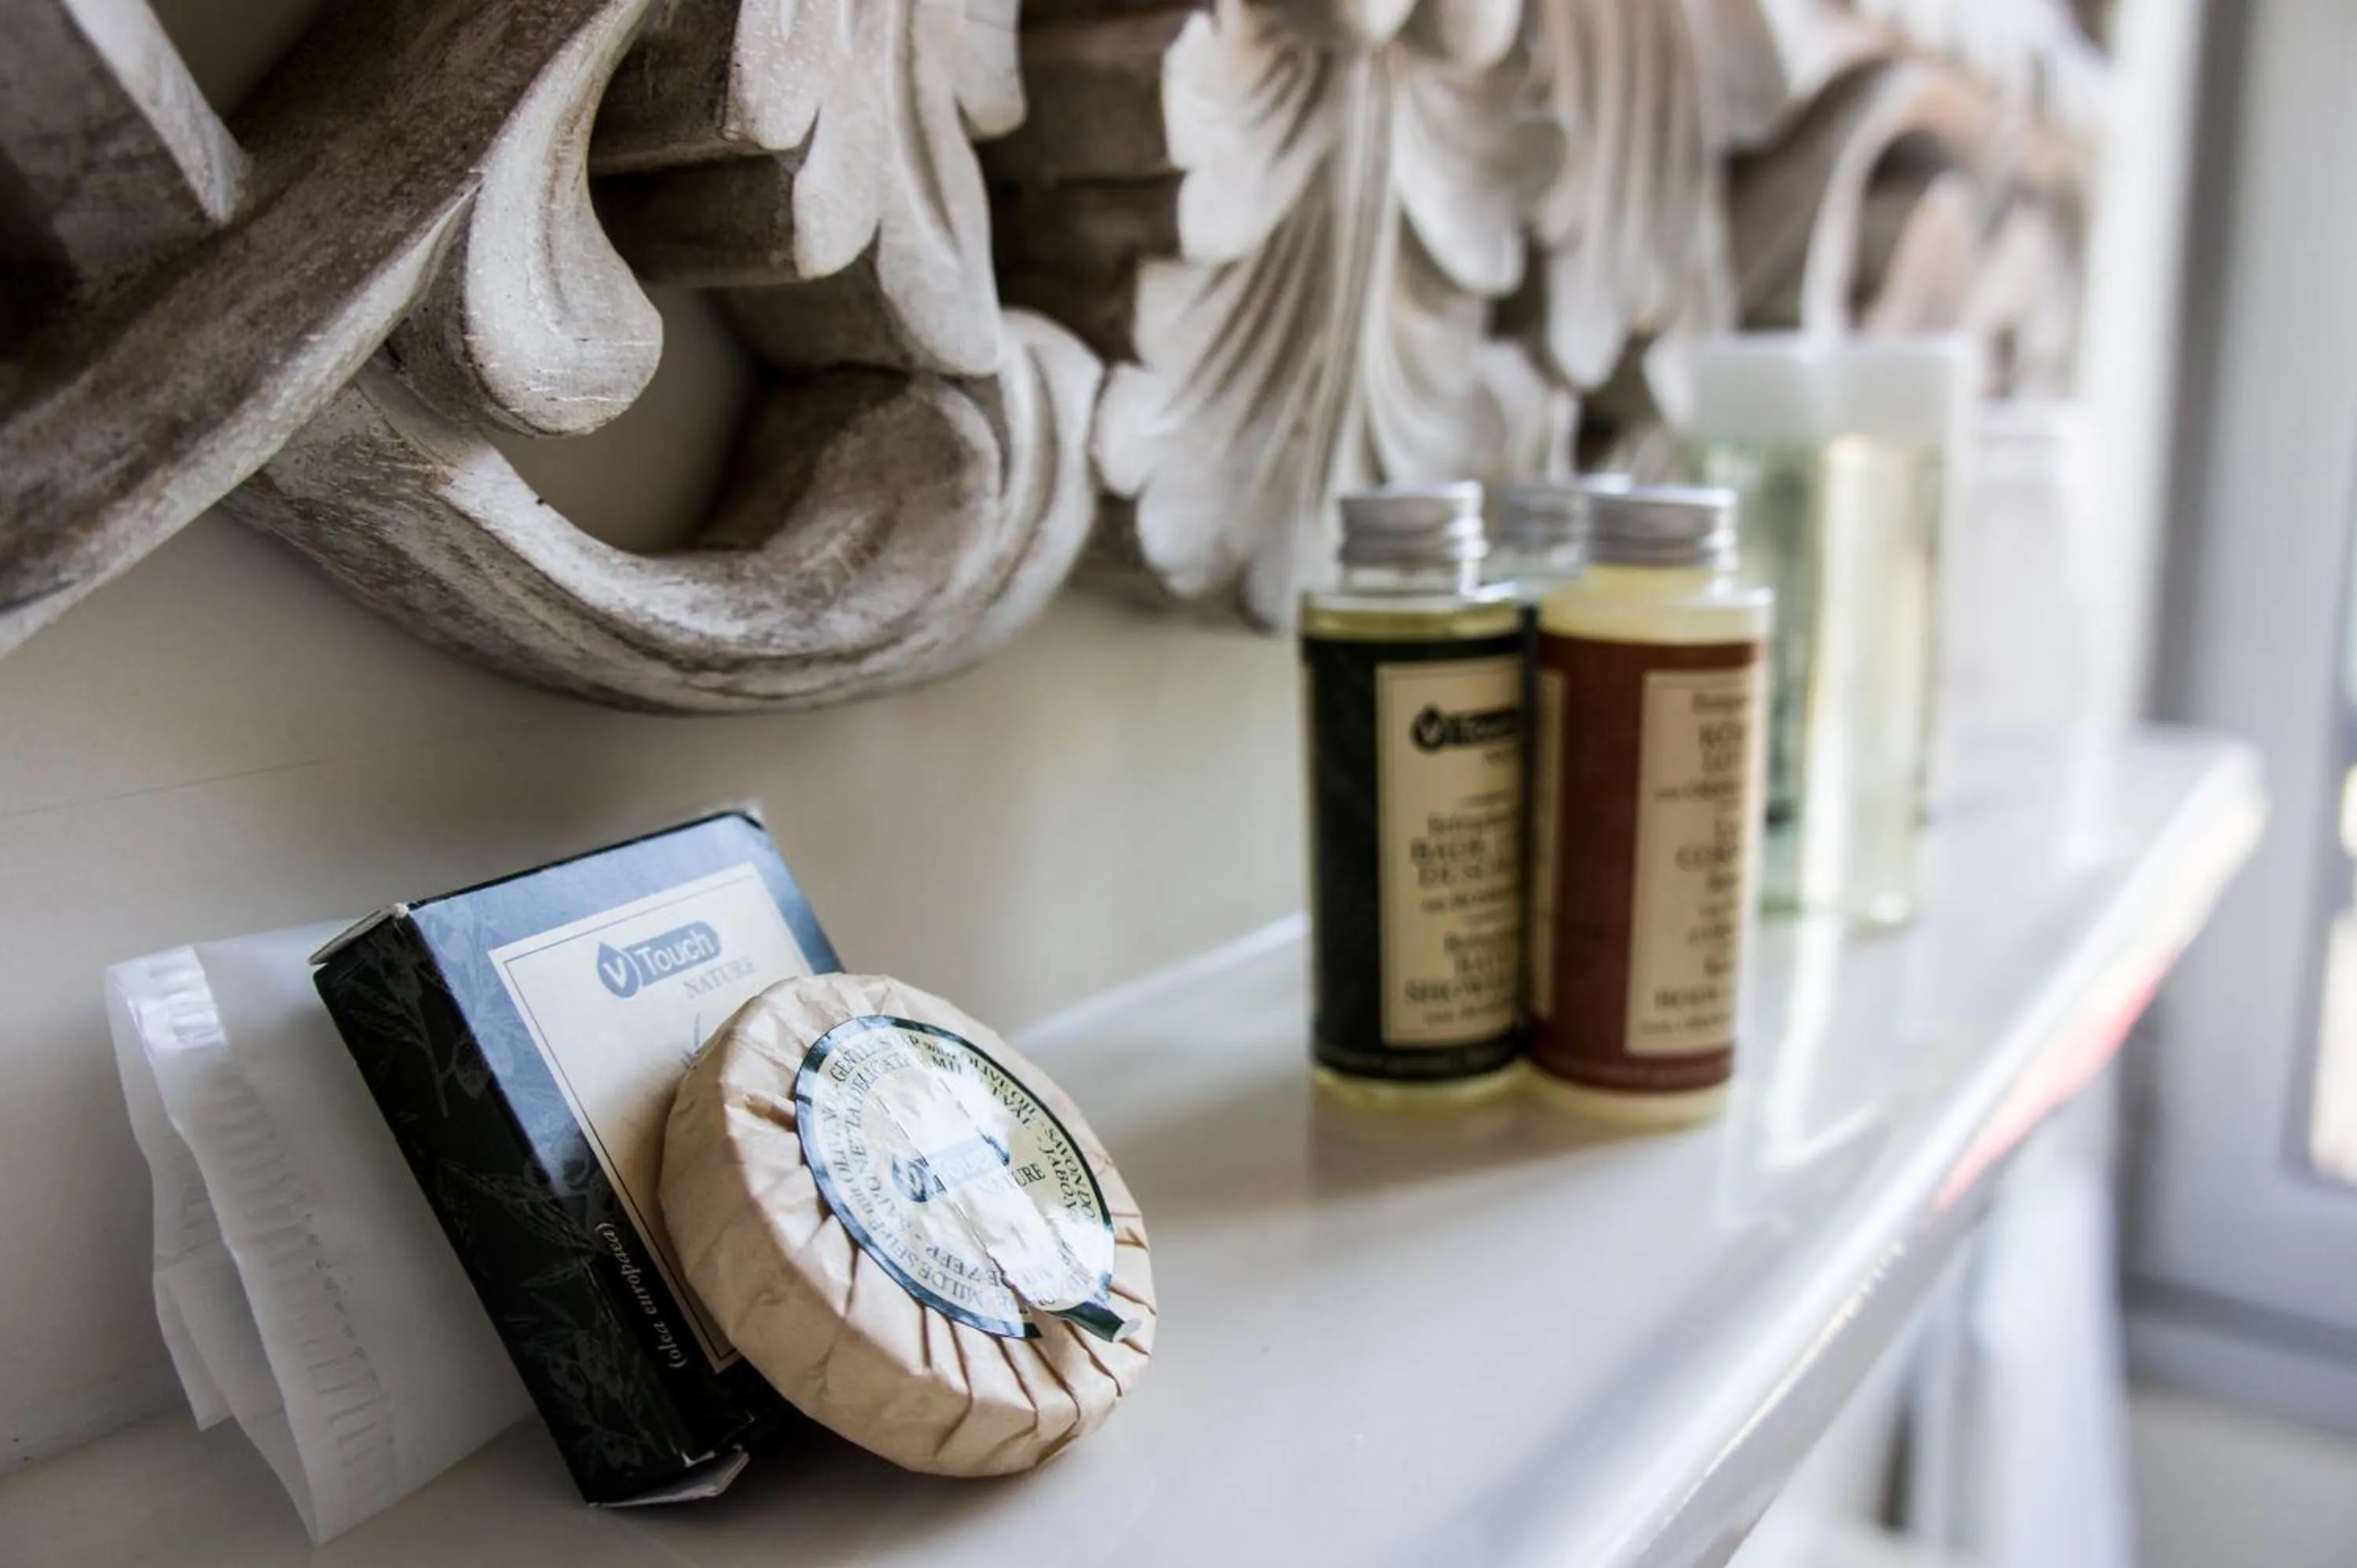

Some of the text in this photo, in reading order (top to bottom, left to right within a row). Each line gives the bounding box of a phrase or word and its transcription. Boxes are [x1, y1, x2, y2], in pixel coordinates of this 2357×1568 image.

[635, 929, 713, 976] Touch
[682, 956, 755, 999] NATURE
[918, 1263, 984, 1310] MILDE
